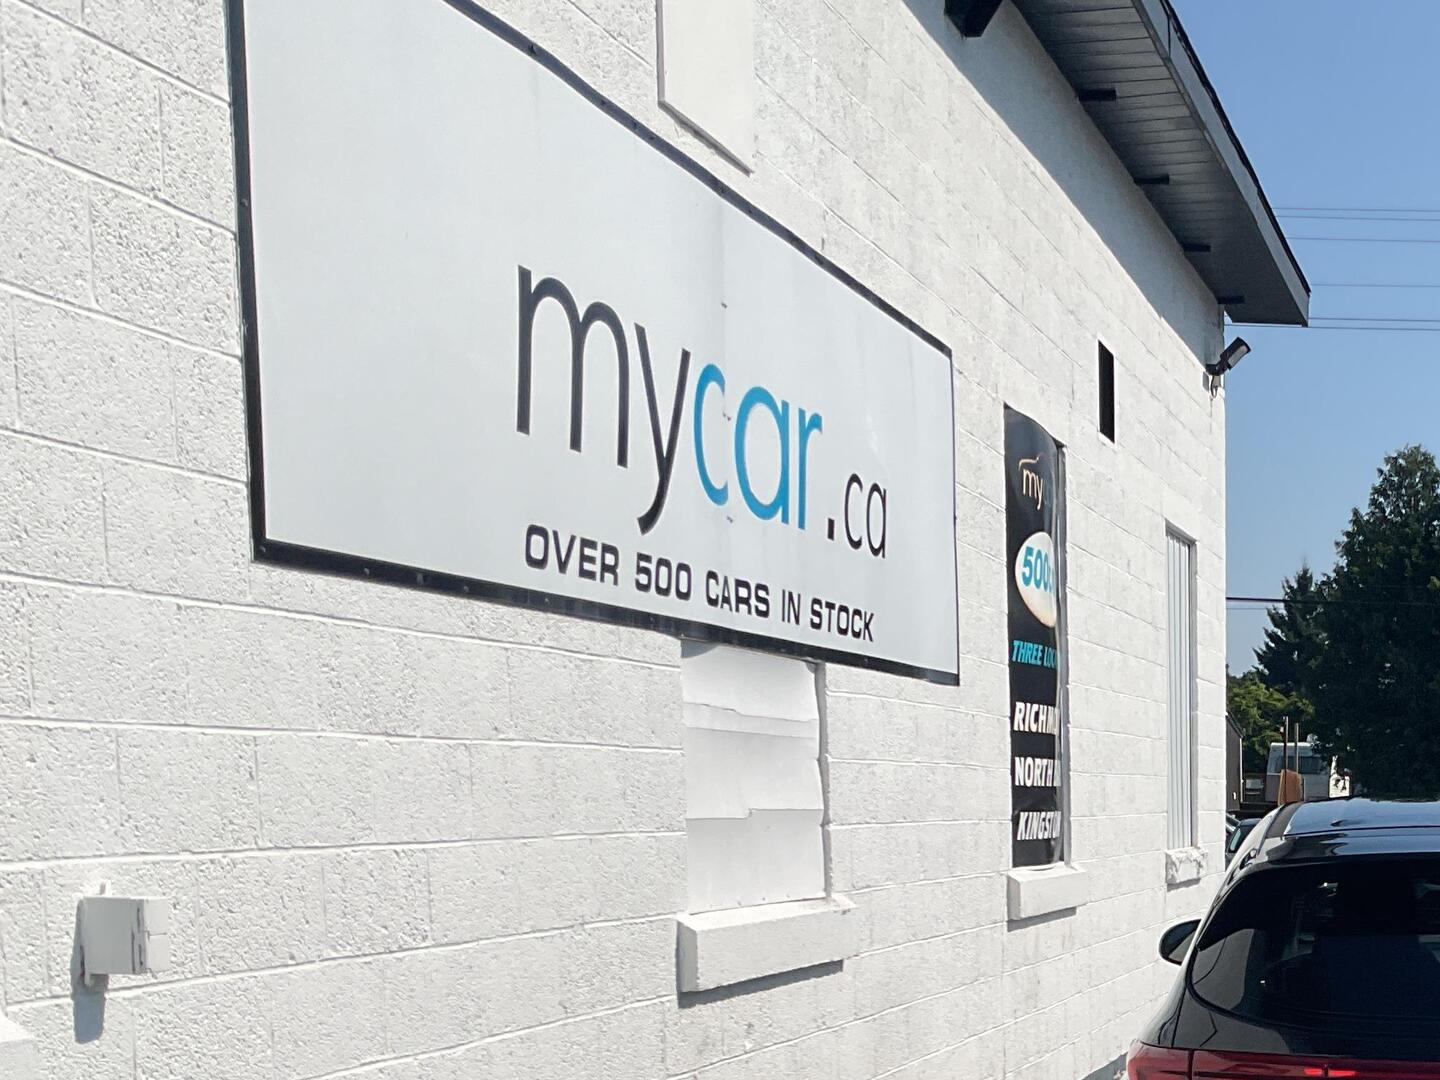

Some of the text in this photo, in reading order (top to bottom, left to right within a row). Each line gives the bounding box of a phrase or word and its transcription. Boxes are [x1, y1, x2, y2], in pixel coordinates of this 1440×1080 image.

[525, 523, 875, 643] OVER 500 CARS IN STOCK
[1011, 639, 1044, 666] THREE
[1014, 756, 1054, 788] NORTH
